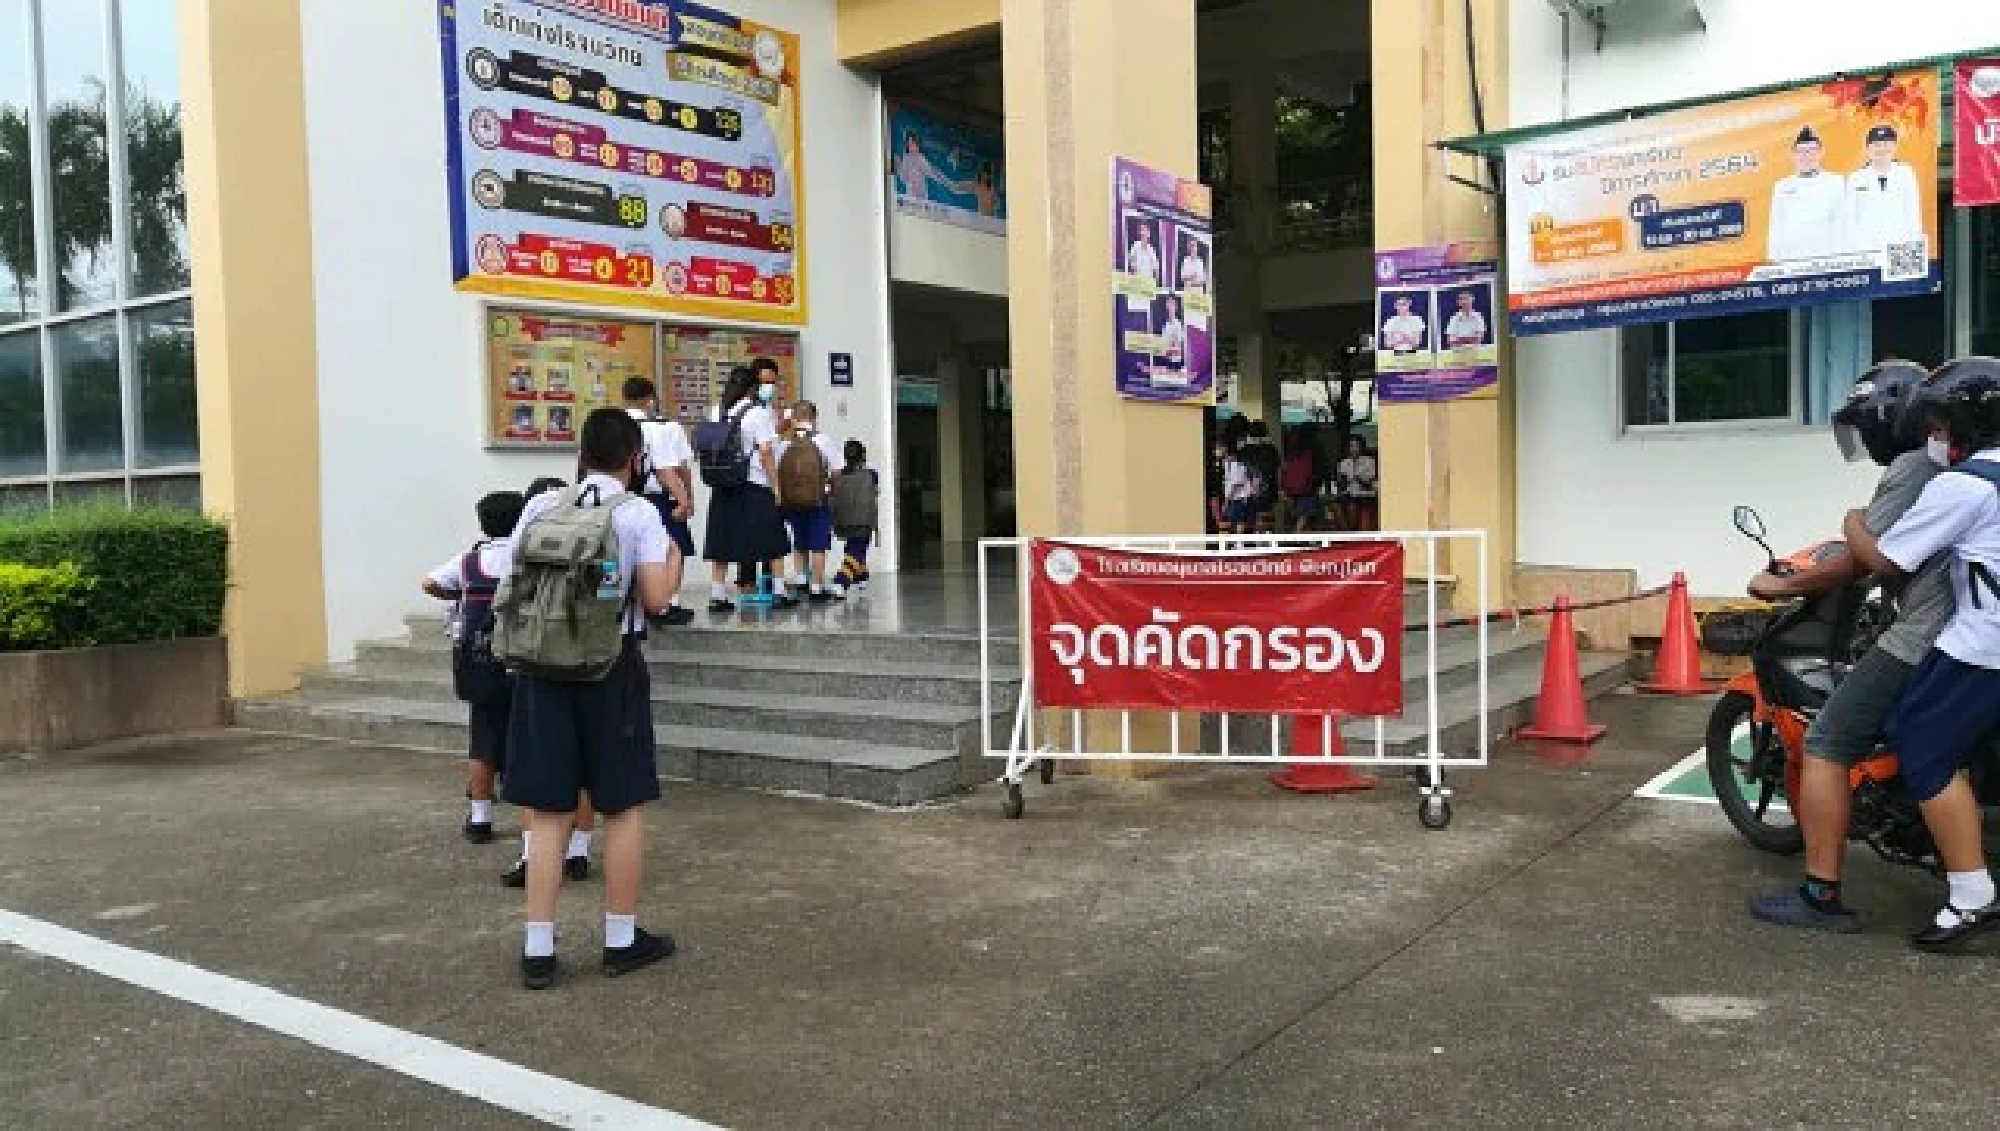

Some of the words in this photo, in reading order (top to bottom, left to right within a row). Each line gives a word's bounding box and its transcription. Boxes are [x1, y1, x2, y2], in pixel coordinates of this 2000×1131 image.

[1699, 153, 1759, 179] 2564
[618, 197, 646, 223] 88
[627, 258, 650, 283] 21
[1049, 606, 1386, 686] จุดคัดกรอง
